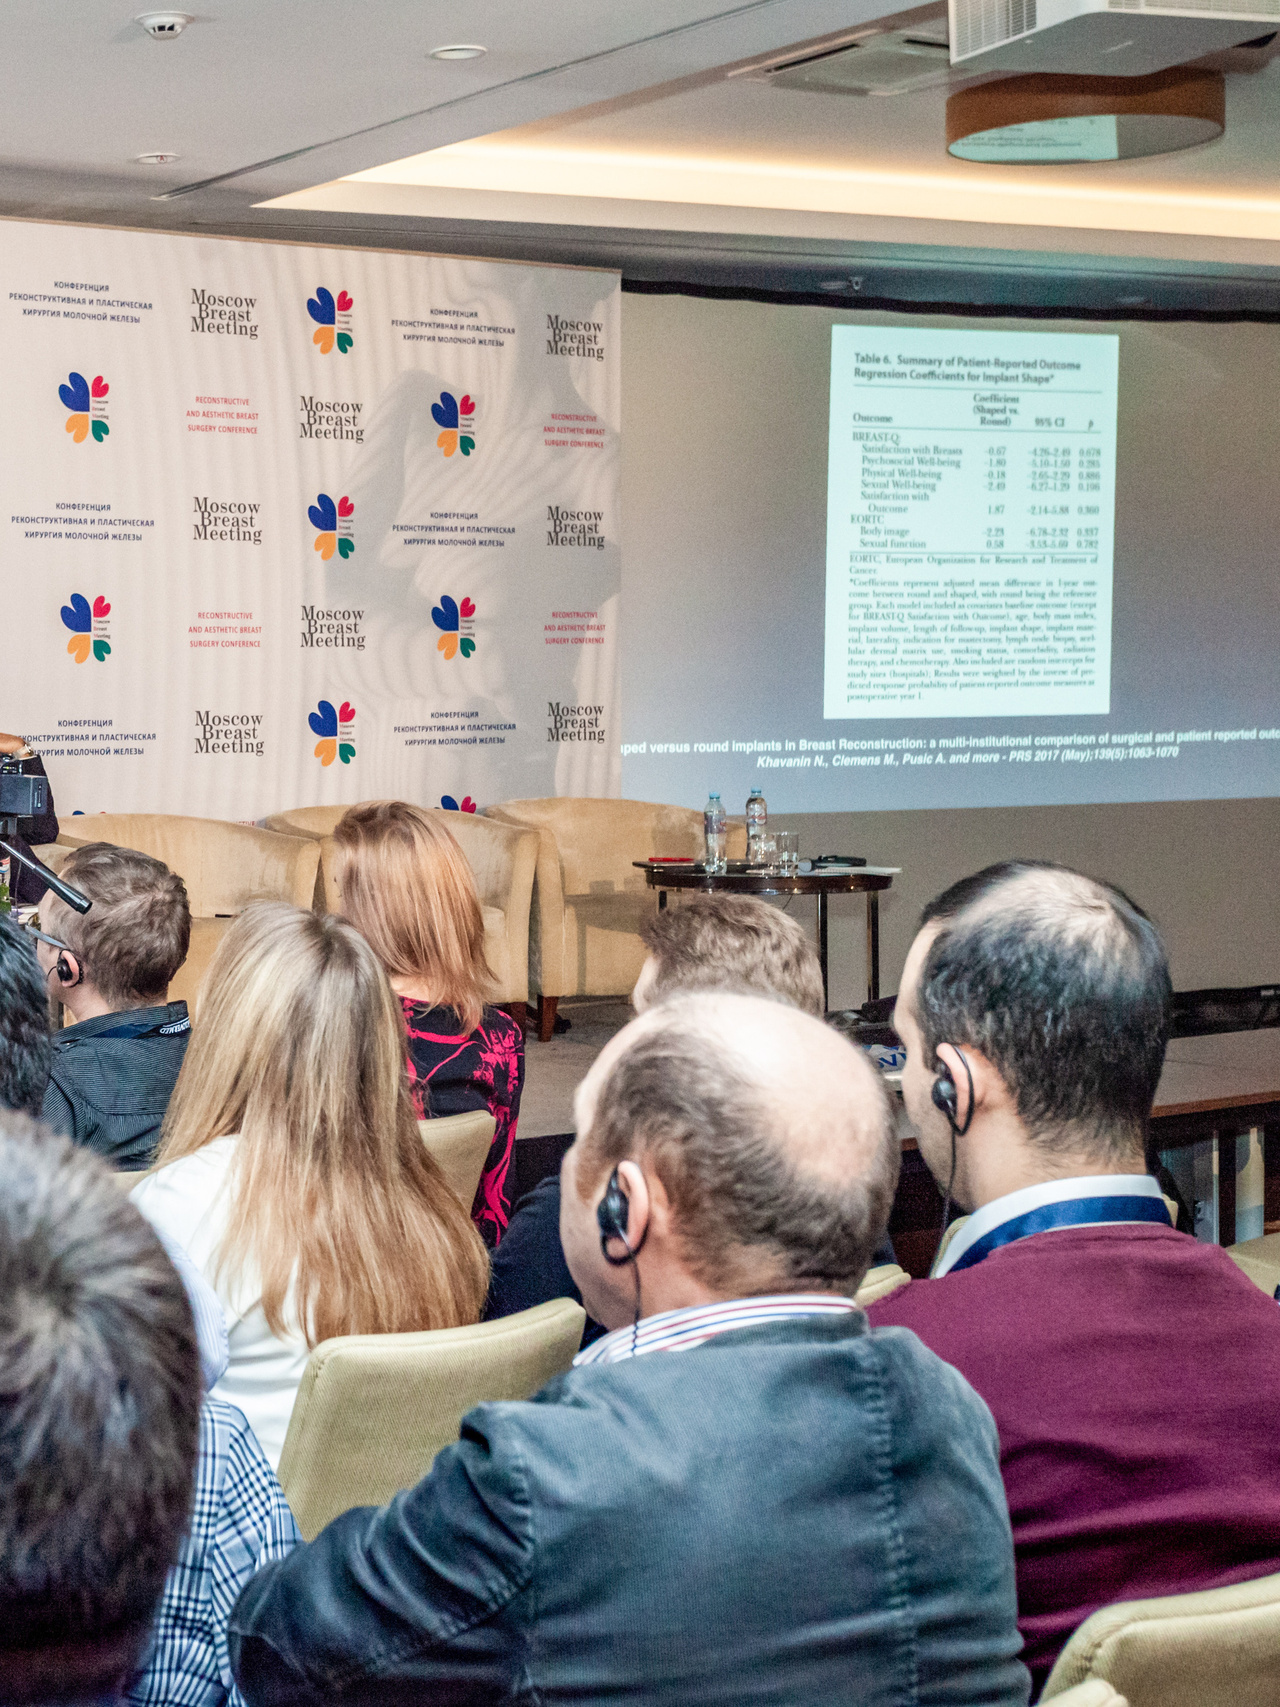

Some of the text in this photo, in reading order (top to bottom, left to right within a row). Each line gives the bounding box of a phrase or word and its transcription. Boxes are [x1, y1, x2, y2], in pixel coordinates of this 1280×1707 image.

[54, 281, 109, 292] КОНФЕРЕНЦИЯ
[9, 293, 86, 305] РЕКОНСТРУКТИВНАЯ
[96, 299, 152, 310] ПЛАСТИЧЕСКАЯ
[191, 288, 257, 309] Moscow
[22, 309, 60, 317] ХИРУРГИЯ
[63, 311, 107, 321] МОЛОЧНОЙ
[198, 303, 252, 321] Breast
[191, 317, 258, 339] Meeting
[546, 314, 603, 333] Moscow
[552, 328, 598, 344] Breast
[546, 340, 604, 361] Meeting
[854, 352, 1080, 370] Table 6. Summary of Patient-Reported Outcome
[854, 367, 907, 380] Regression
[909, 369, 964, 380] Coefficients
[966, 371, 980, 381] for
[982, 372, 1019, 384] Implant
[300, 396, 363, 414] Moscow
[974, 393, 1019, 403] Coefficient
[306, 410, 358, 426] Breast
[853, 412, 893, 422] Outcome
[973, 405, 1006, 416] (Shaped
[980, 417, 1011, 426] Round)
[1054, 418, 1064, 427] CI
[299, 423, 364, 443] Meeting
[56, 503, 111, 512] КОНФЕРЕНЦИЯ
[193, 497, 261, 514] Moscow
[11, 516, 88, 525] РЕКОНСТРУКТИВНАЯ
[200, 511, 255, 527] Breast
[547, 506, 604, 522] Moscow
[553, 519, 599, 533] Breast
[65, 531, 109, 540] МОЛОЧНОЙ
[193, 525, 262, 544] Meeting
[546, 532, 605, 549] Meeting
[860, 539, 926, 548] Sexual function
[300, 605, 364, 621] Moscow
[307, 619, 359, 634] Breast
[300, 633, 365, 650] Meeting
[547, 702, 604, 717] Moscow
[195, 710, 264, 726] Moscow
[554, 714, 599, 730] Breast
[202, 724, 258, 740] Breast
[547, 728, 605, 743] Meeting
[194, 739, 265, 756] Meeting
[650, 743, 689, 752] versus
[693, 740, 728, 752] round
[732, 740, 781, 754] implants
[785, 739, 795, 750] in
[799, 739, 835, 750] Breast
[838, 737, 926, 749] Reconstruction:
[929, 738, 936, 748] a
[938, 734, 1031, 747] multi-institutional
[1033, 733, 1095, 747] comparison
[1097, 732, 1109, 744] of
[1111, 731, 1152, 746] surgical
[1154, 730, 1174, 742] and
[1176, 729, 1212, 744] patient
[1214, 727, 1257, 743] reported
[756, 755, 810, 767] Khavanin
[813, 754, 828, 767] N.,
[832, 754, 880, 766] Clemens
[883, 753, 898, 766] M.,
[902, 752, 932, 764] Pusic
[934, 752, 946, 763] A.
[948, 751, 970, 764] and
[972, 752, 1000, 763] more
[1008, 750, 1032, 761] PRS
[1034, 749, 1059, 761] 2017
